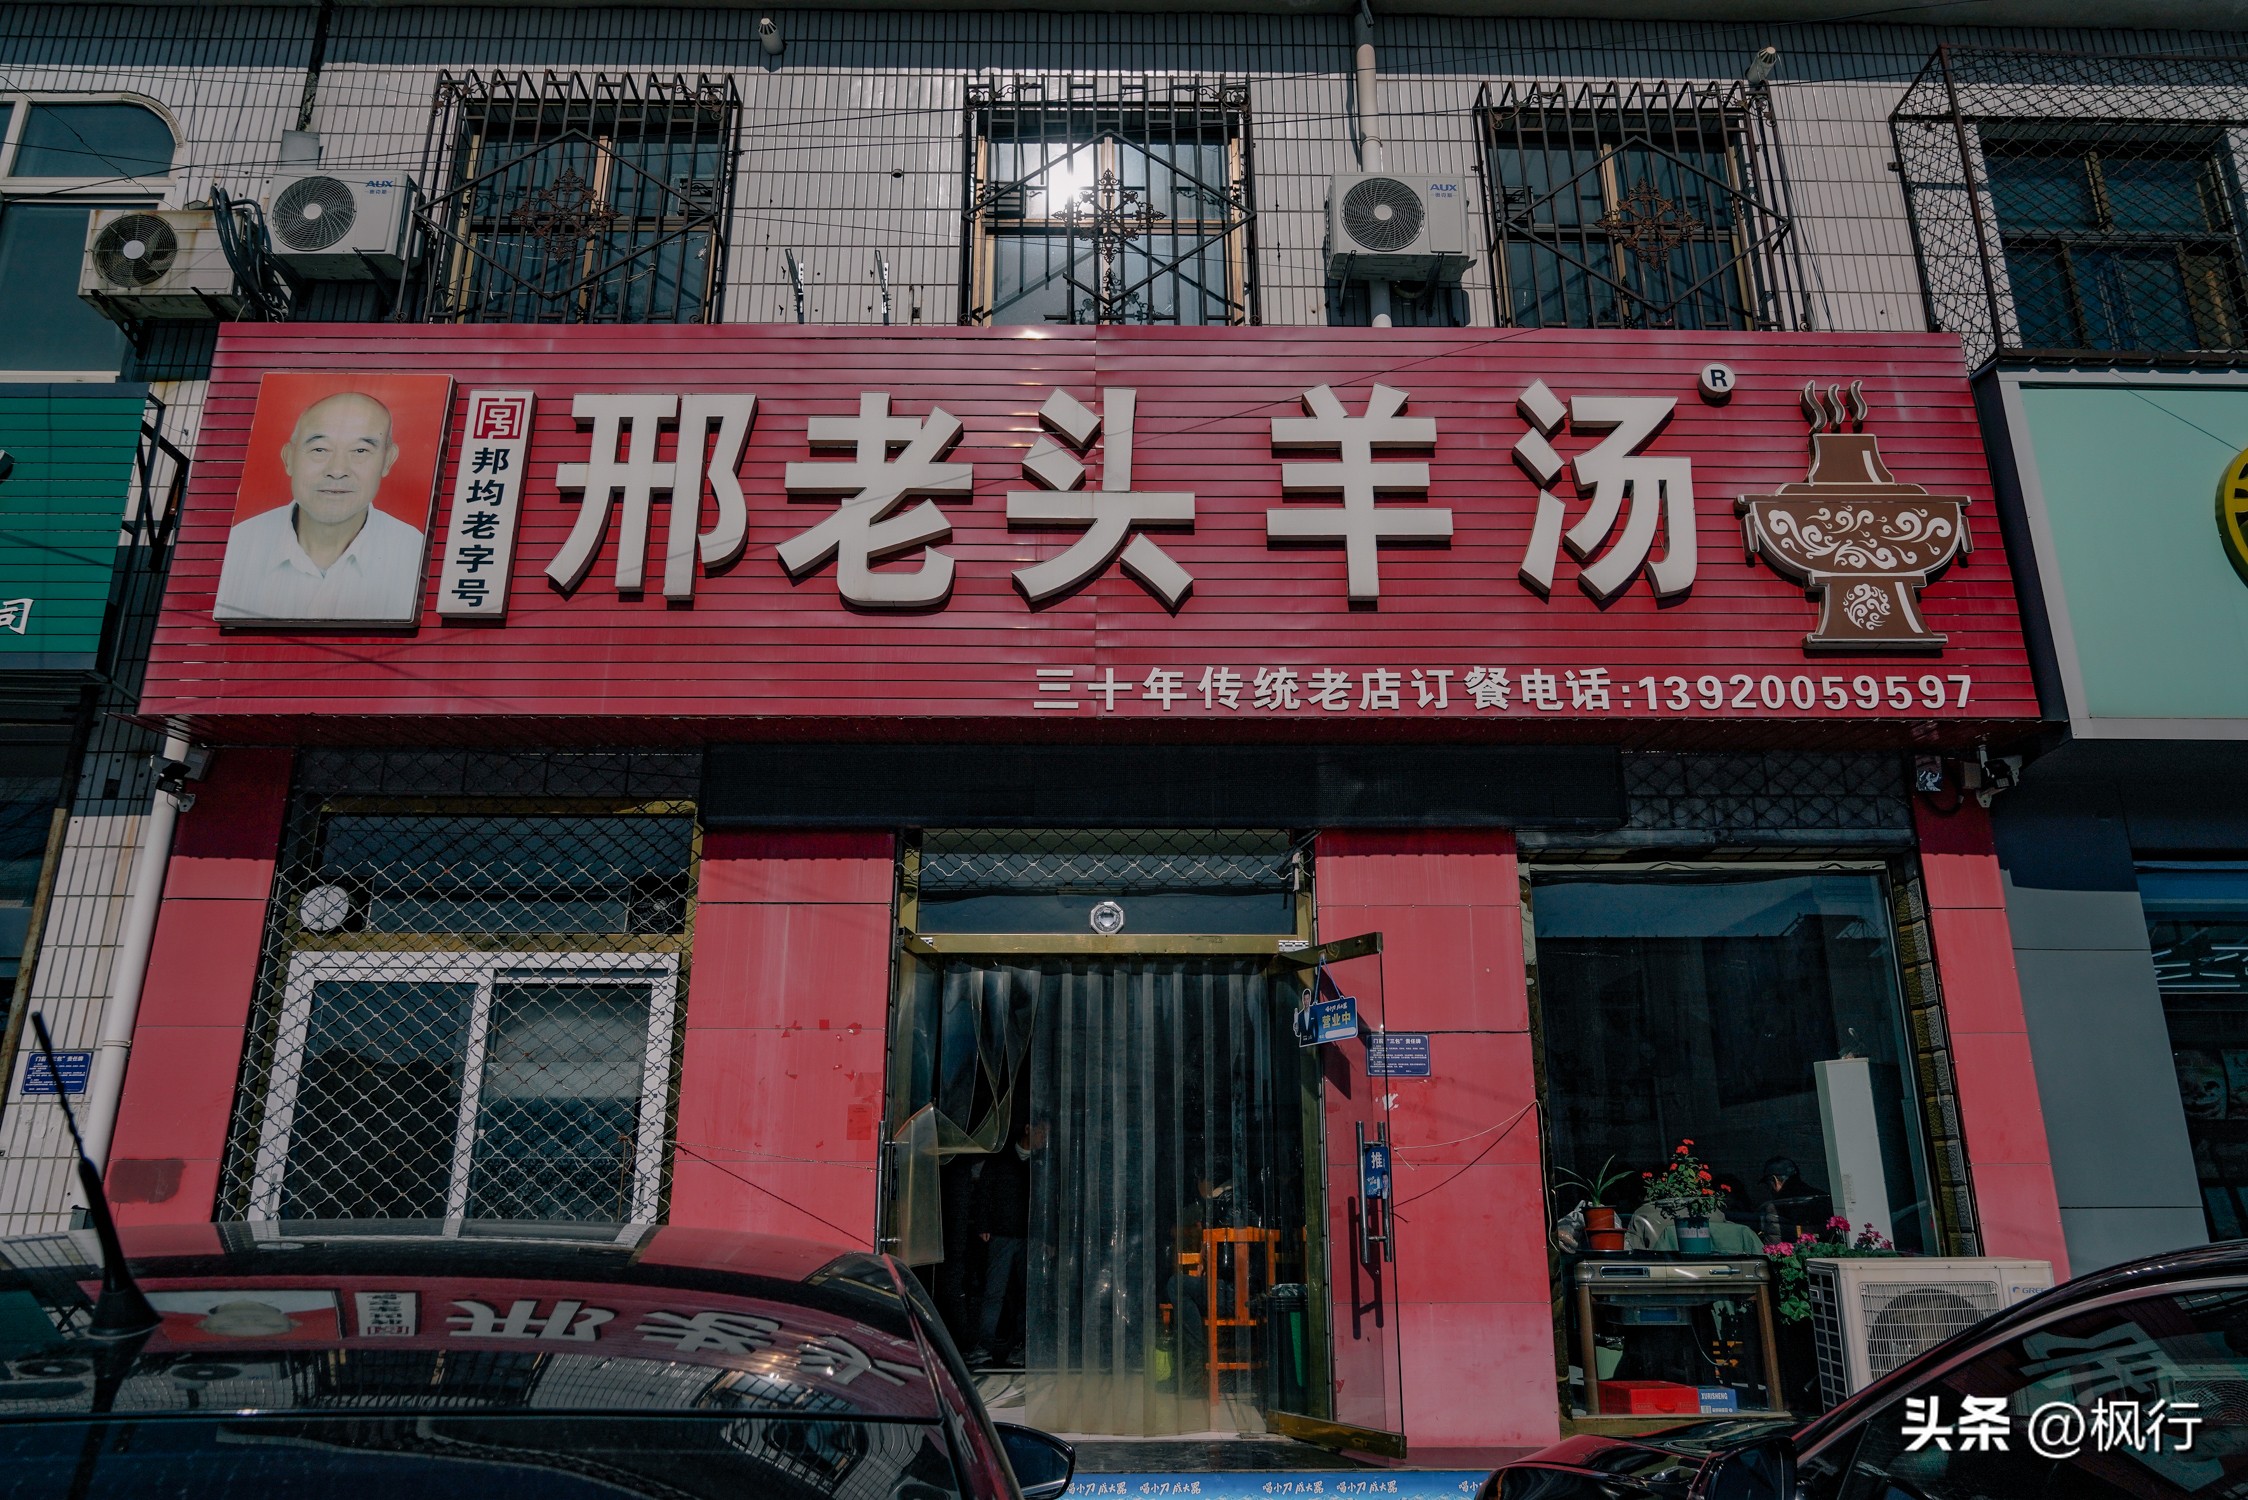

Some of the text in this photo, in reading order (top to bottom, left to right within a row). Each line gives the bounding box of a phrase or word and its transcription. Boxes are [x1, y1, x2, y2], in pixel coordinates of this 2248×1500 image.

[366, 180, 393, 188] AUX
[1430, 183, 1457, 191] AUX
[545, 378, 1698, 608] 邢老头羊汤
[451, 446, 511, 608] 邦均老字号
[1321, 1011, 1351, 1029] 营业中
[1371, 1151, 1383, 1169] 推
